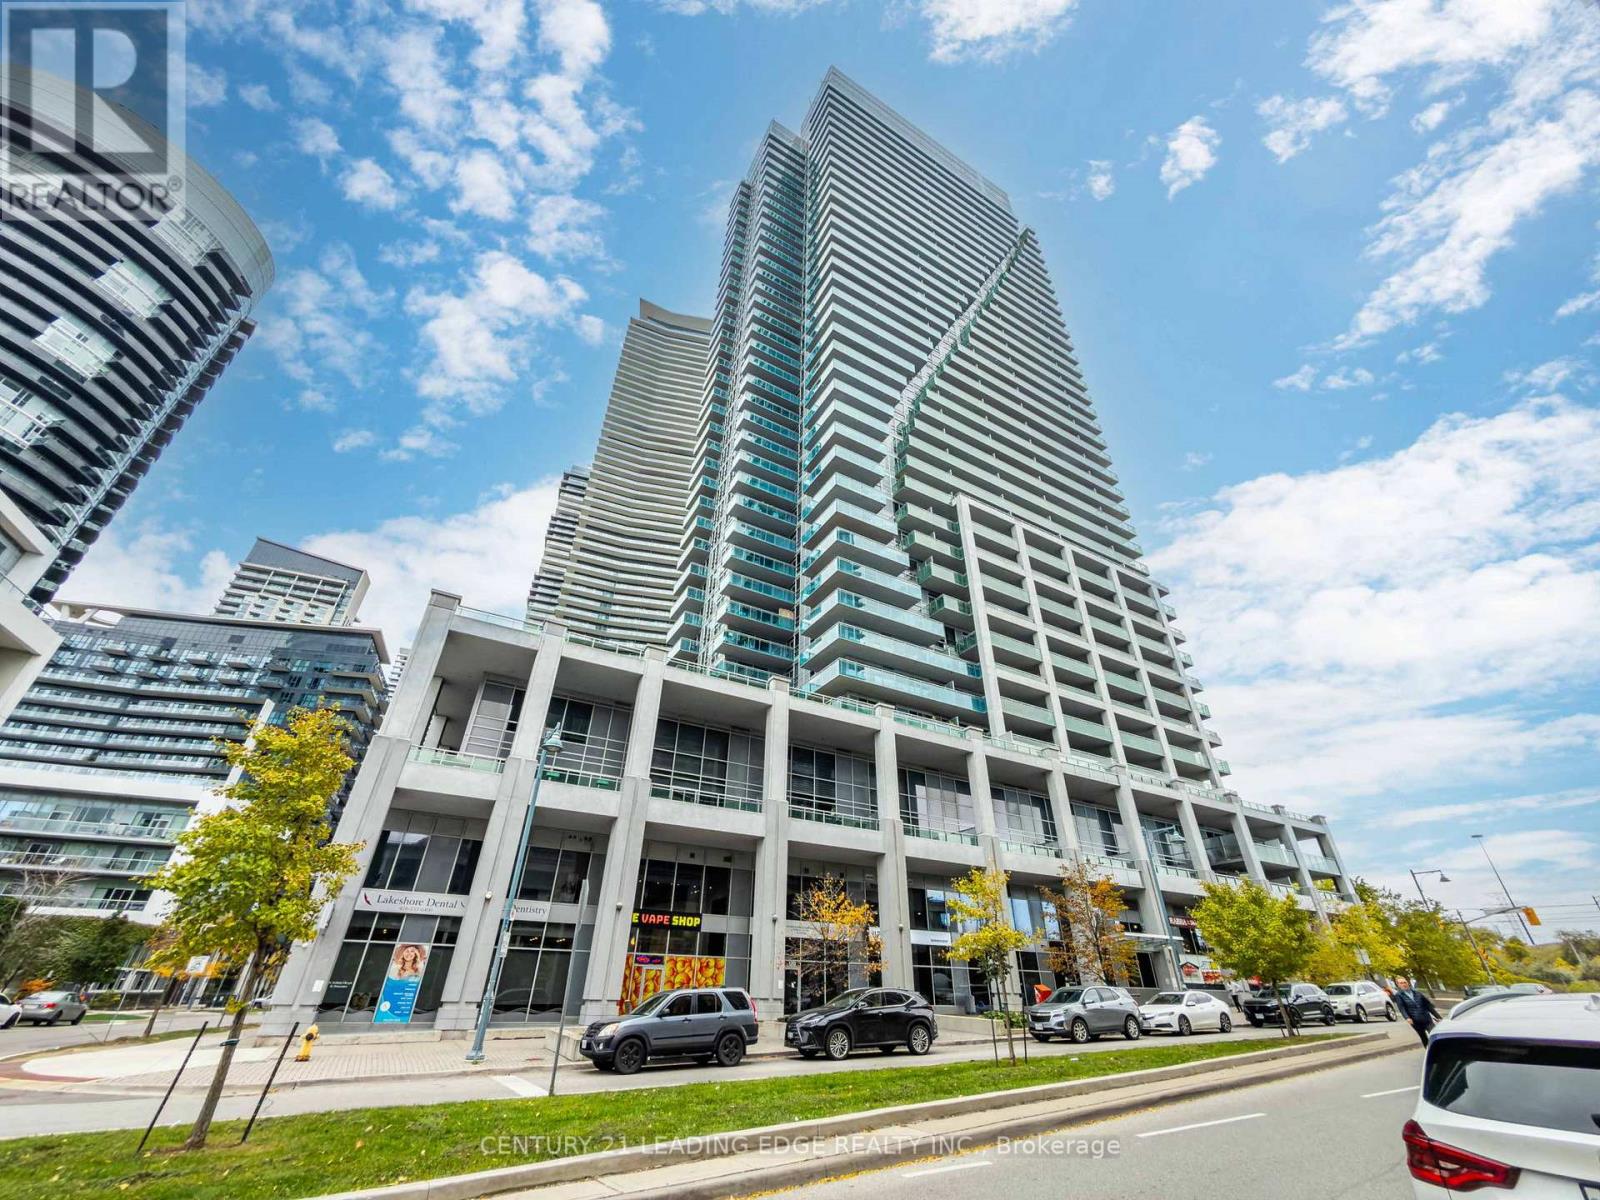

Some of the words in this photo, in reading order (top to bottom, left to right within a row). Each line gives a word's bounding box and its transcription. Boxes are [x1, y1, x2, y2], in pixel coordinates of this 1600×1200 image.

[376, 894, 424, 906] Lakeshore
[426, 898, 457, 909] Dental
[641, 913, 671, 925] VAPE
[671, 915, 701, 927] SHOP
